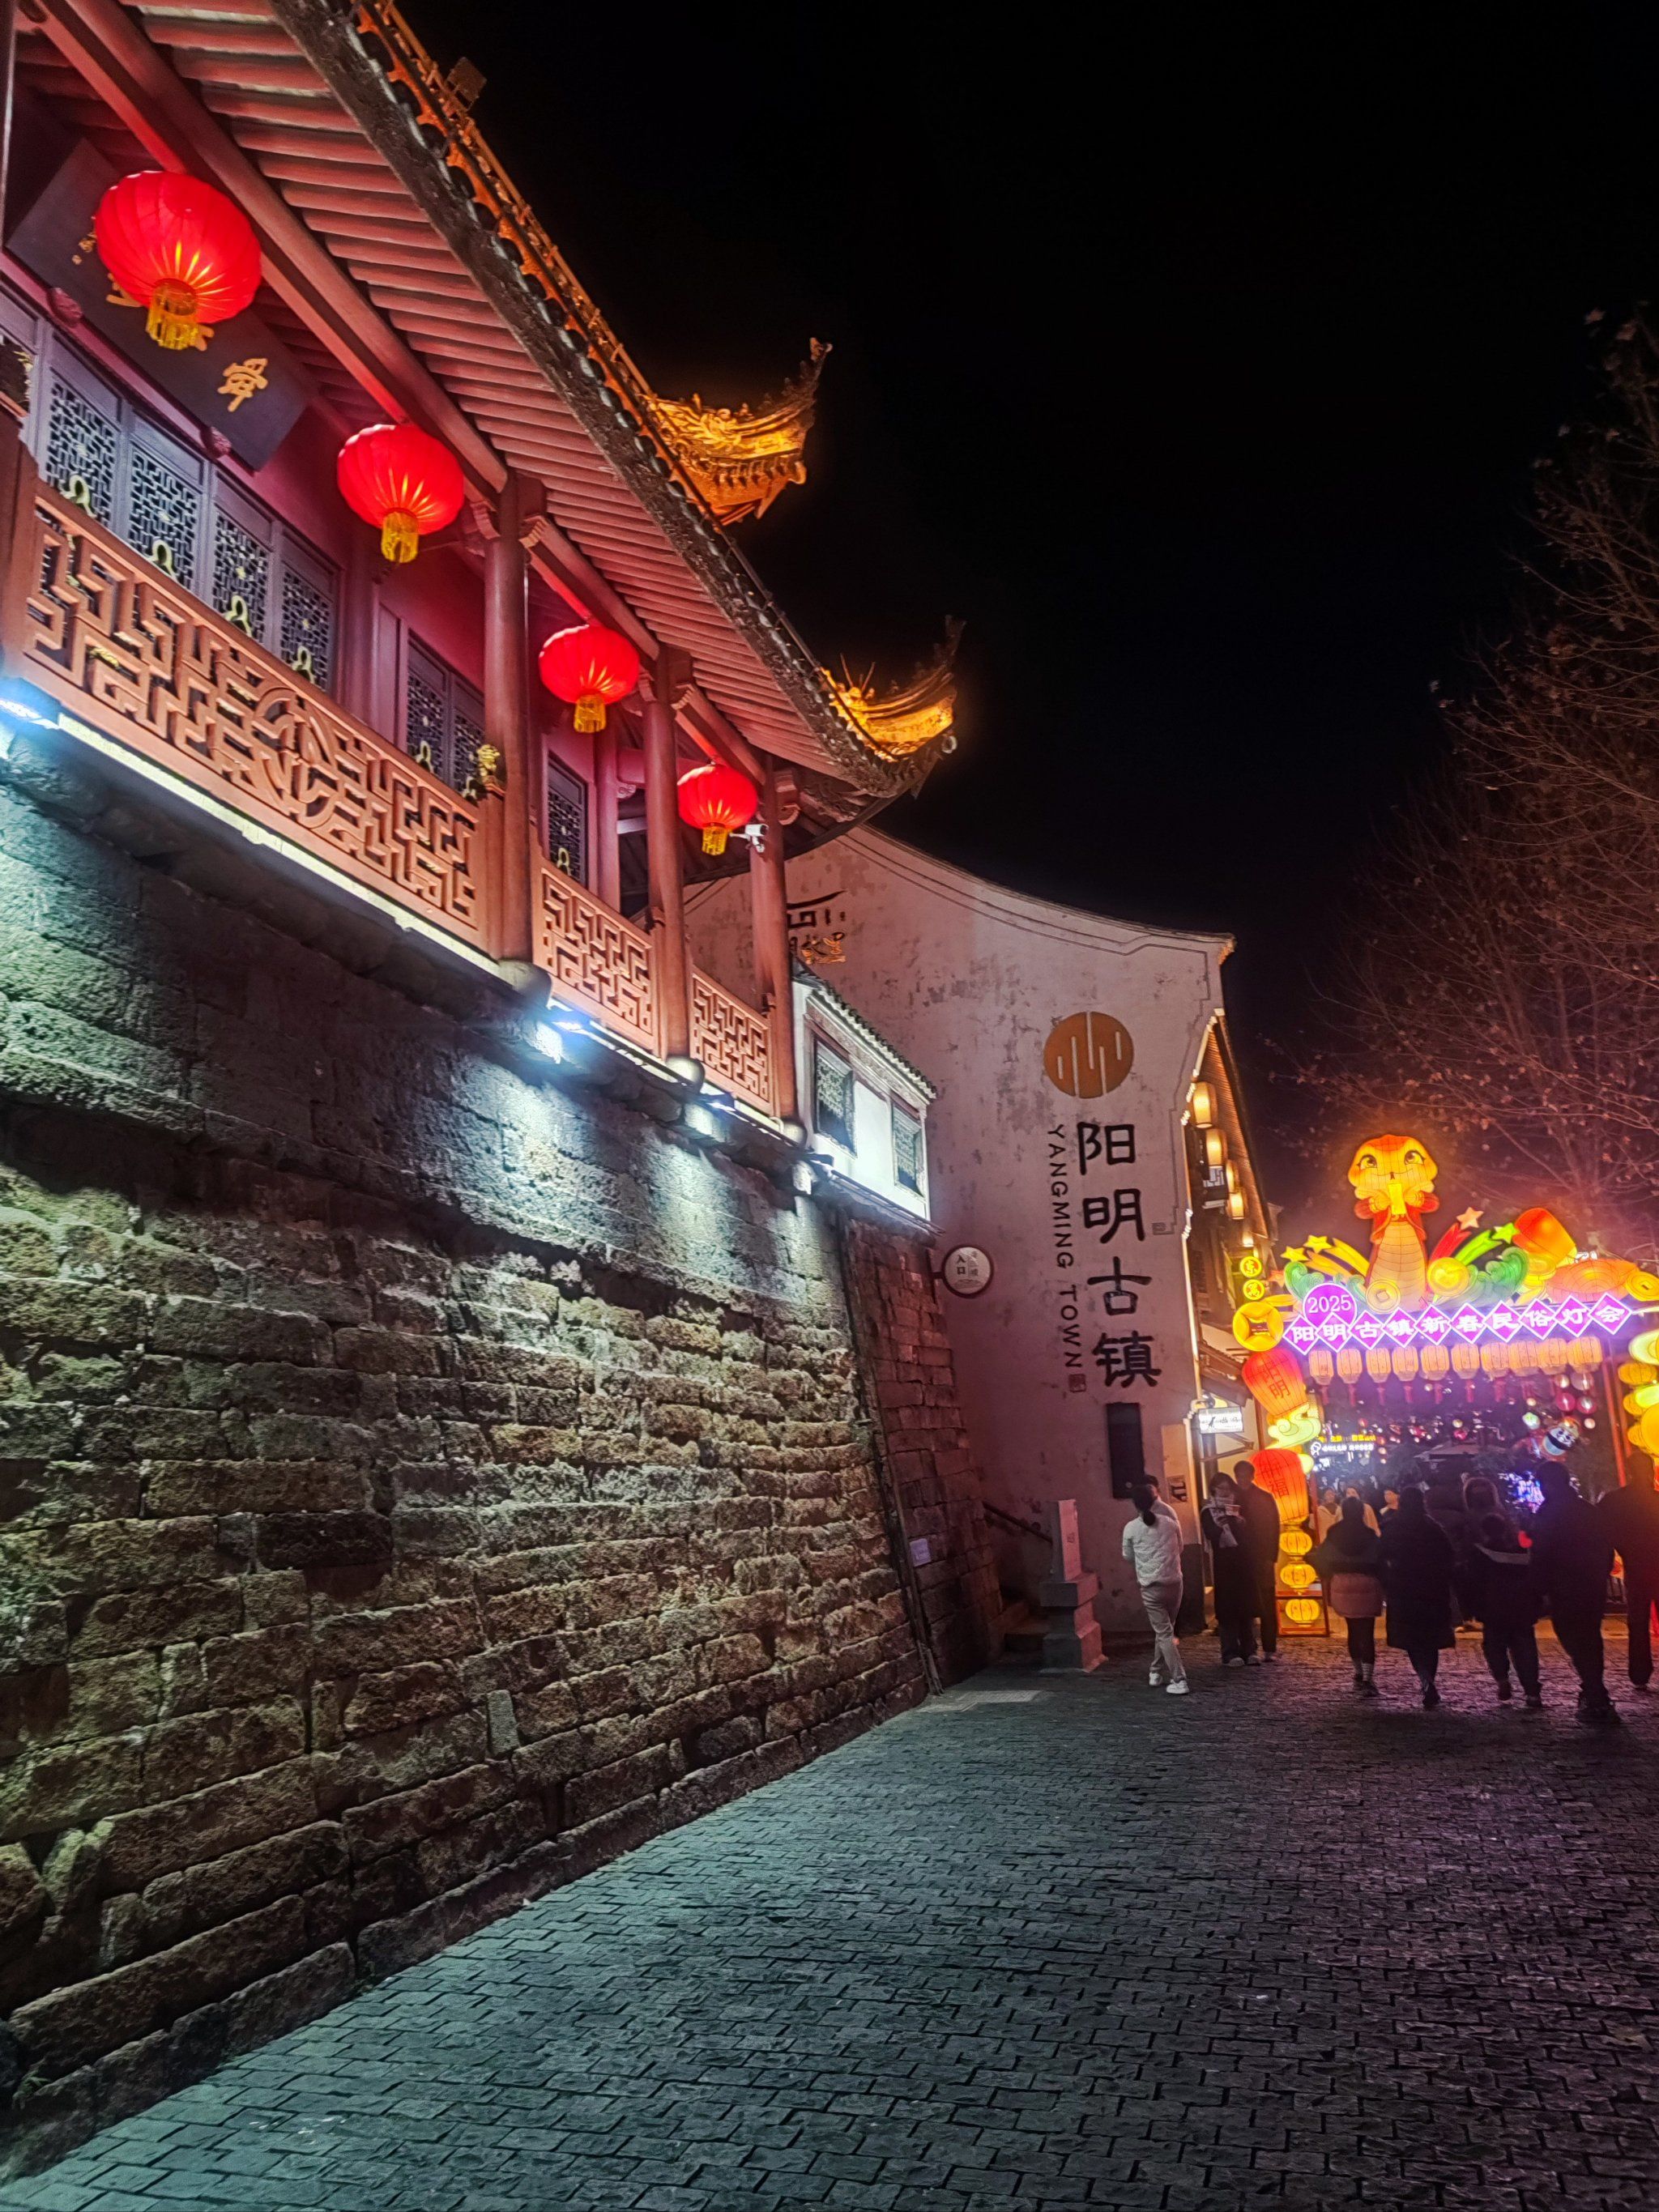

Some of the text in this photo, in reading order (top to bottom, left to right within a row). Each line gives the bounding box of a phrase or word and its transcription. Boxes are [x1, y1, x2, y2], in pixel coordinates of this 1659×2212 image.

[1047, 1123, 1074, 1269] YANGMING
[956, 1254, 966, 1276] 入口
[1077, 1121, 1162, 1388] 阳明古镇
[1059, 1284, 1083, 1368] TOWN
[1292, 1305, 1624, 1344] 阳明古镇新春民俗灯会
[1307, 1294, 1352, 1314] 2025
